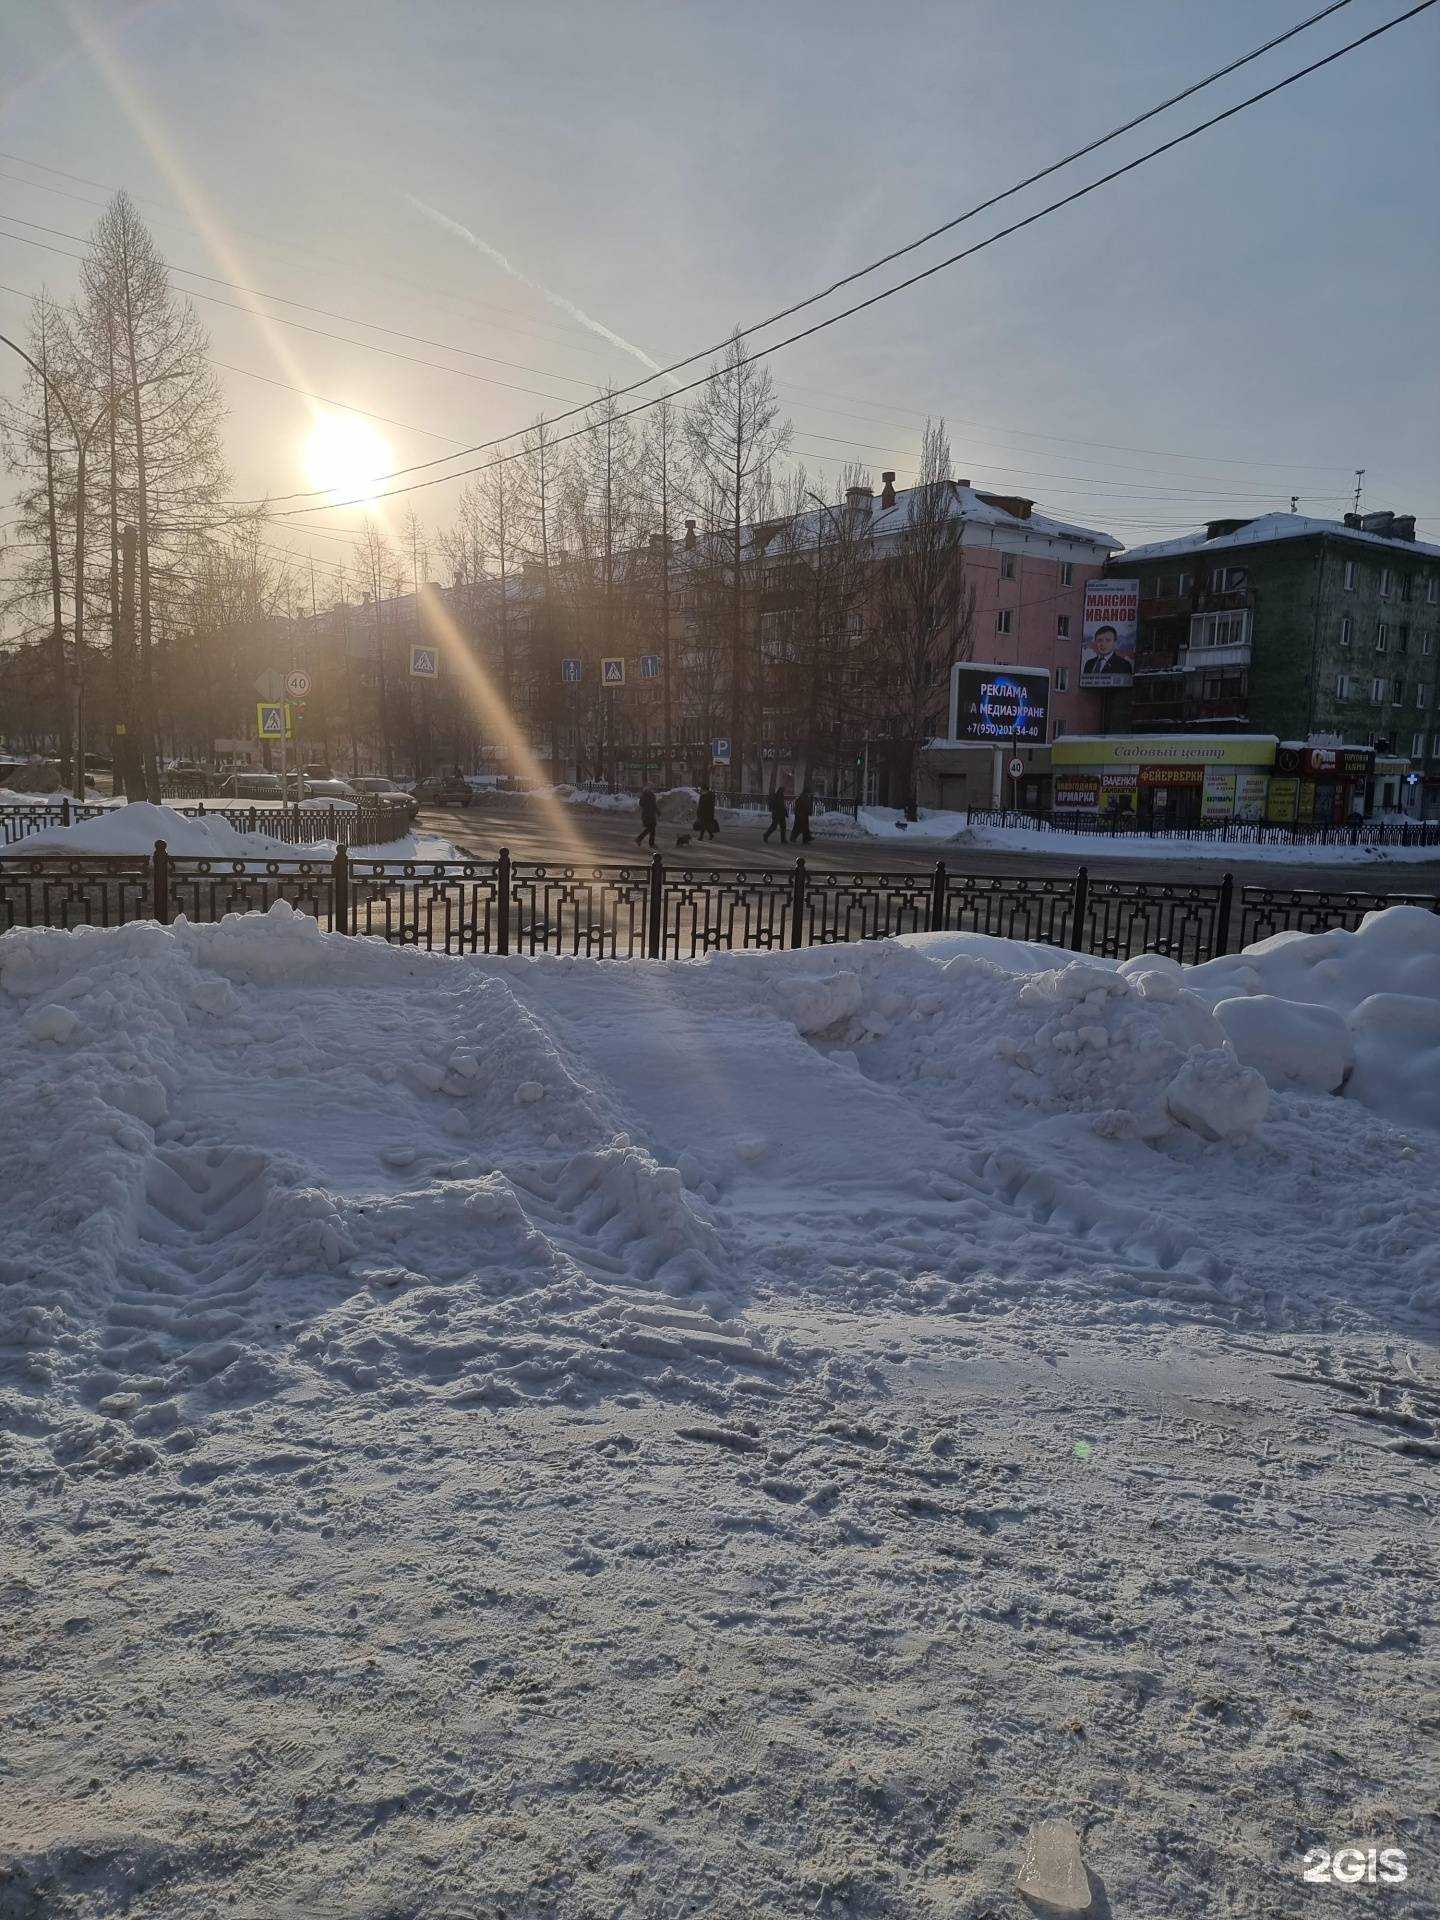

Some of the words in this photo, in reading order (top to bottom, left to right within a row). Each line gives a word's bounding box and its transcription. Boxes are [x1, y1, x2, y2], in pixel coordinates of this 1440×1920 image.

[1086, 594, 1137, 606] МАКСИМ
[1085, 608, 1136, 621] ИВАНОВ
[290, 678, 306, 689] 40
[980, 684, 1028, 698] РЕКЛАМА
[979, 703, 1044, 718] МЕДИАЭКРАНЕ
[1114, 745, 1178, 759] Садовый
[1181, 747, 1225, 760] центр
[1011, 763, 1021, 771] 40
[1102, 774, 1137, 787] ВАЛЕНКИ
[1141, 769, 1204, 783] ФЕЙЕРВЕРКИ
[1056, 791, 1095, 802] ЯРМАРКА
